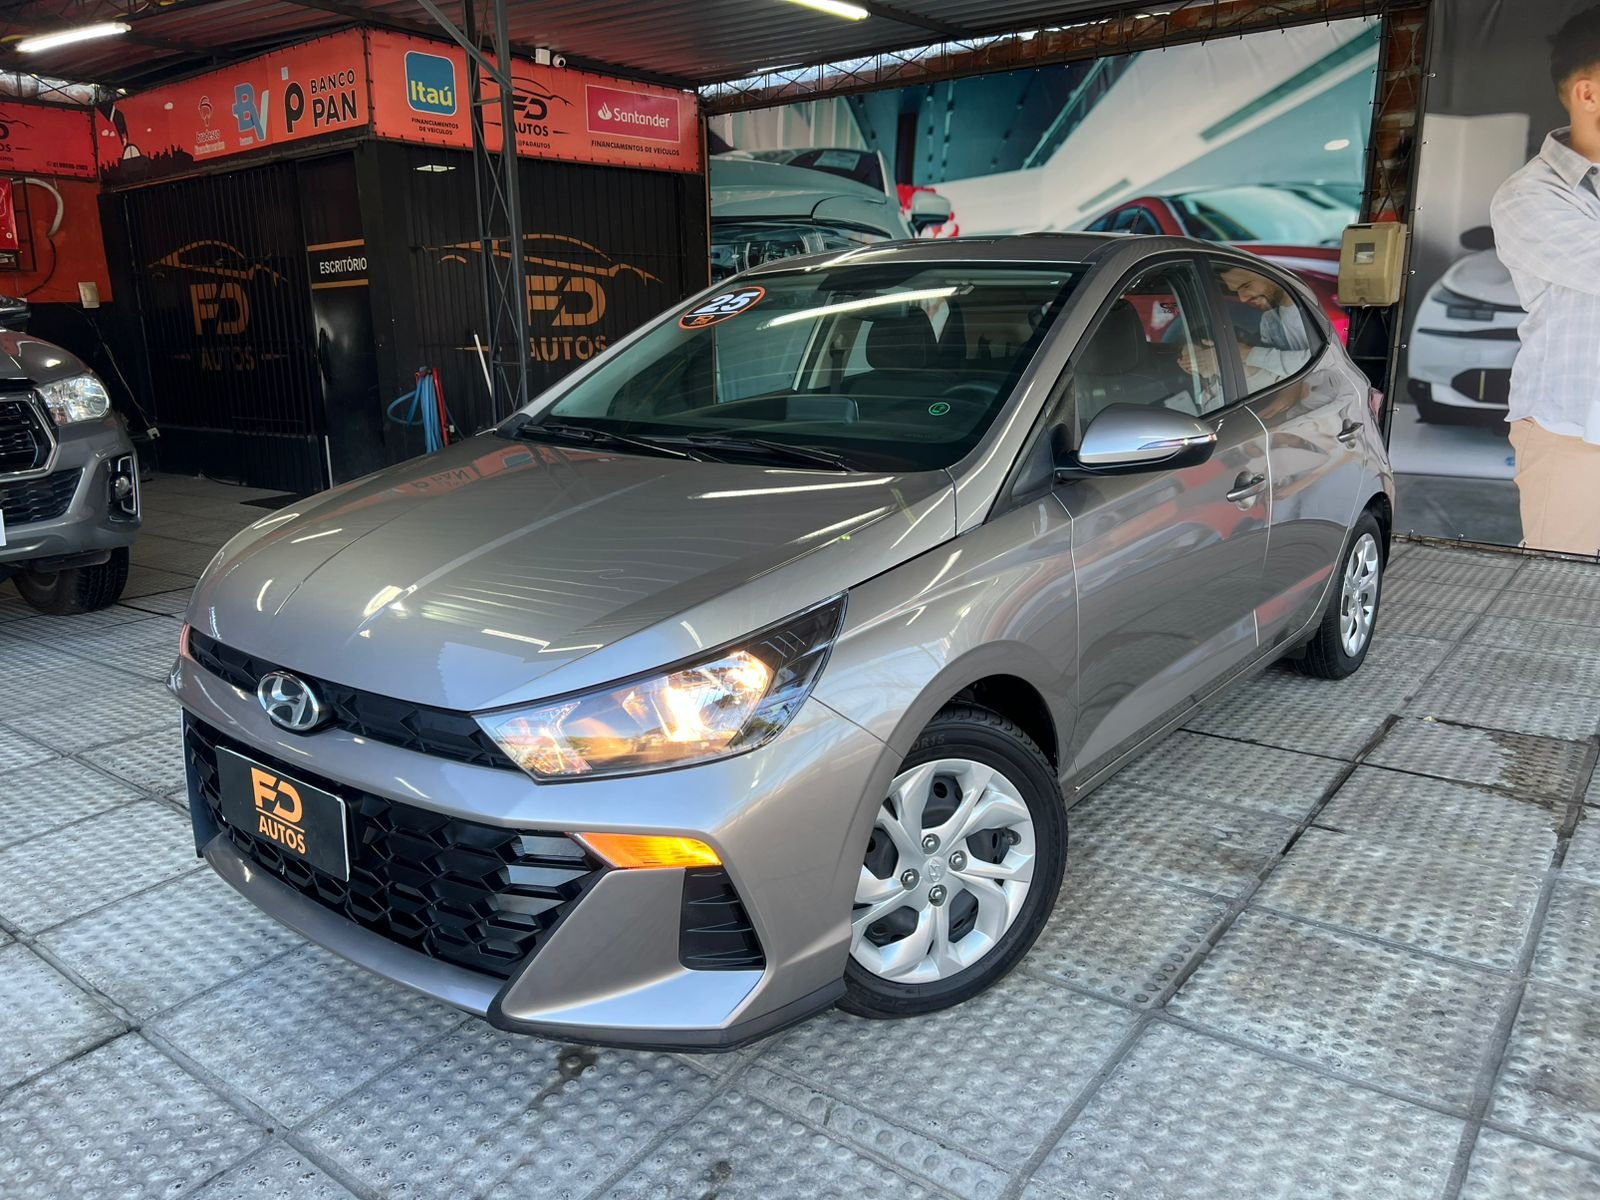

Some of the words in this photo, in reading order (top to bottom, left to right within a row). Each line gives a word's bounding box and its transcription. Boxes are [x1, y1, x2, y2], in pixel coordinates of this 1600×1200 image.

[310, 69, 356, 93] BANCO
[410, 79, 453, 107] Itaú
[312, 89, 358, 128] PAN
[614, 109, 670, 129] Santander
[411, 117, 459, 129] FINANCIAMENTOS
[591, 140, 644, 152] FINANCIAMENTOS
[653, 147, 680, 156] VEÍCULOS
[320, 257, 368, 274] ESCRITÓRIO
[190, 282, 250, 335] FD
[525, 275, 606, 327] FD
[693, 292, 761, 314] 25
[201, 346, 255, 371] AUTOS
[251, 767, 303, 823] FD
[258, 815, 306, 855] AUTOS
